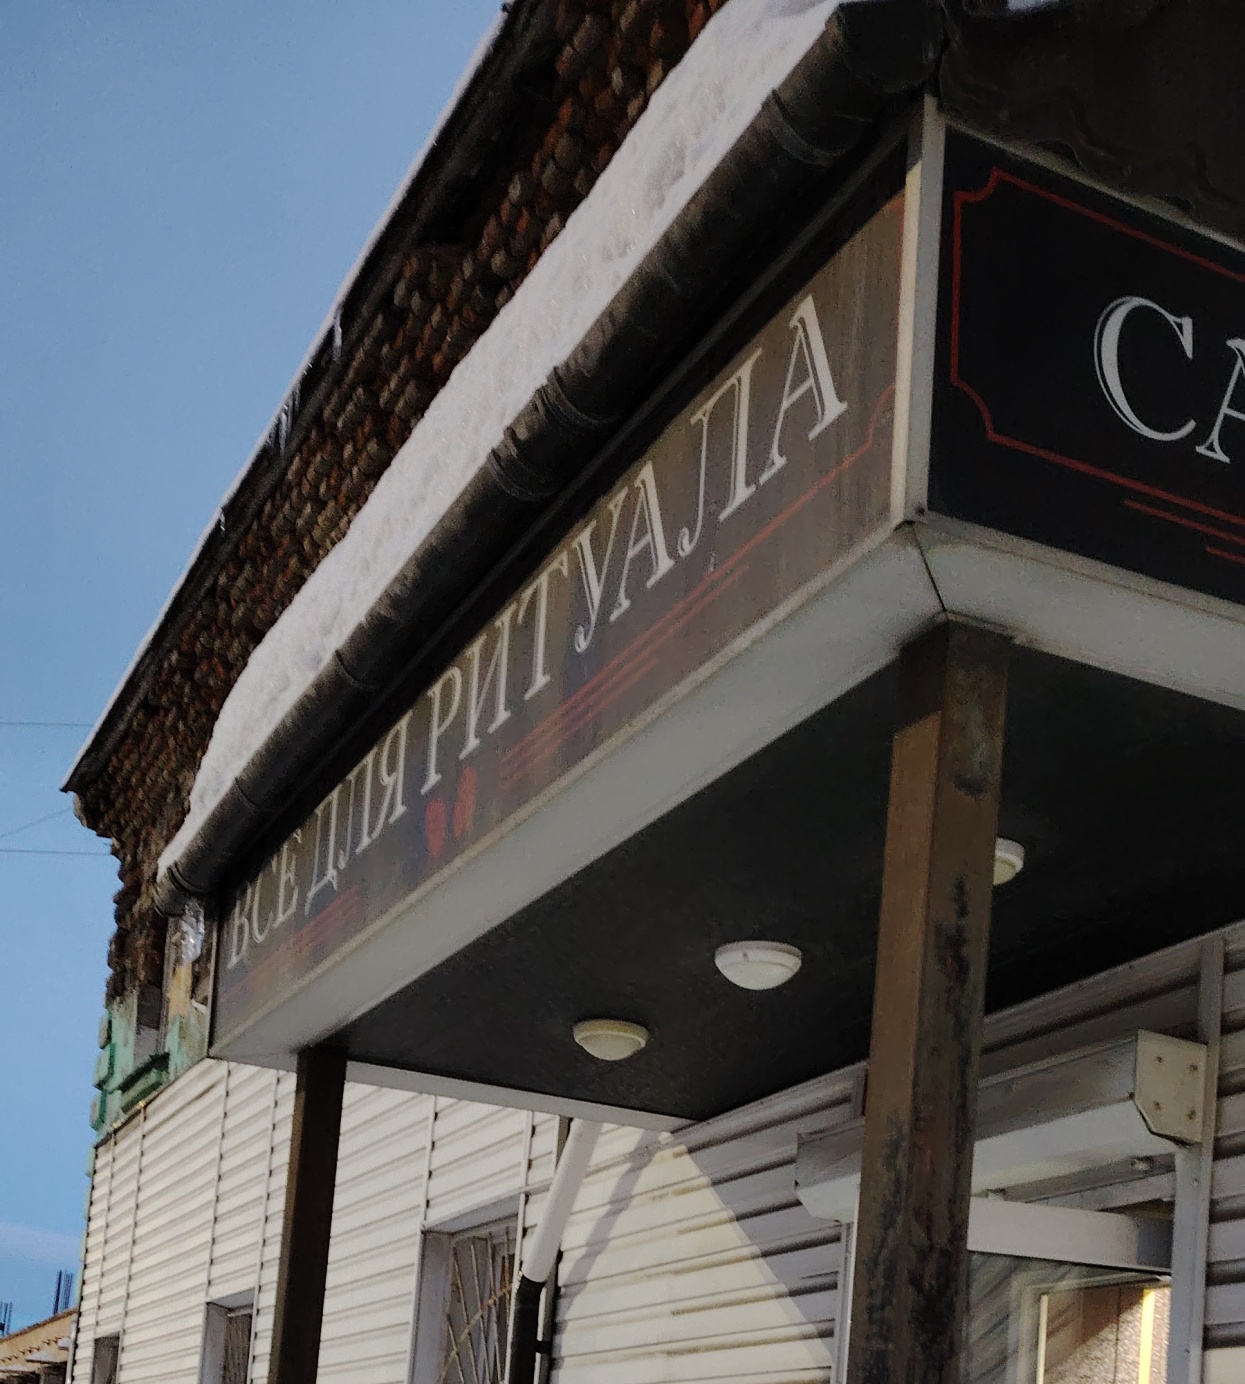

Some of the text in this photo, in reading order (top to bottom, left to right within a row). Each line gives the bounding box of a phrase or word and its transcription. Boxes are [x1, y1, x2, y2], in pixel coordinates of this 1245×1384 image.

[226, 293, 848, 969] ВСЕ ДЛЯ РИТУАЛА
